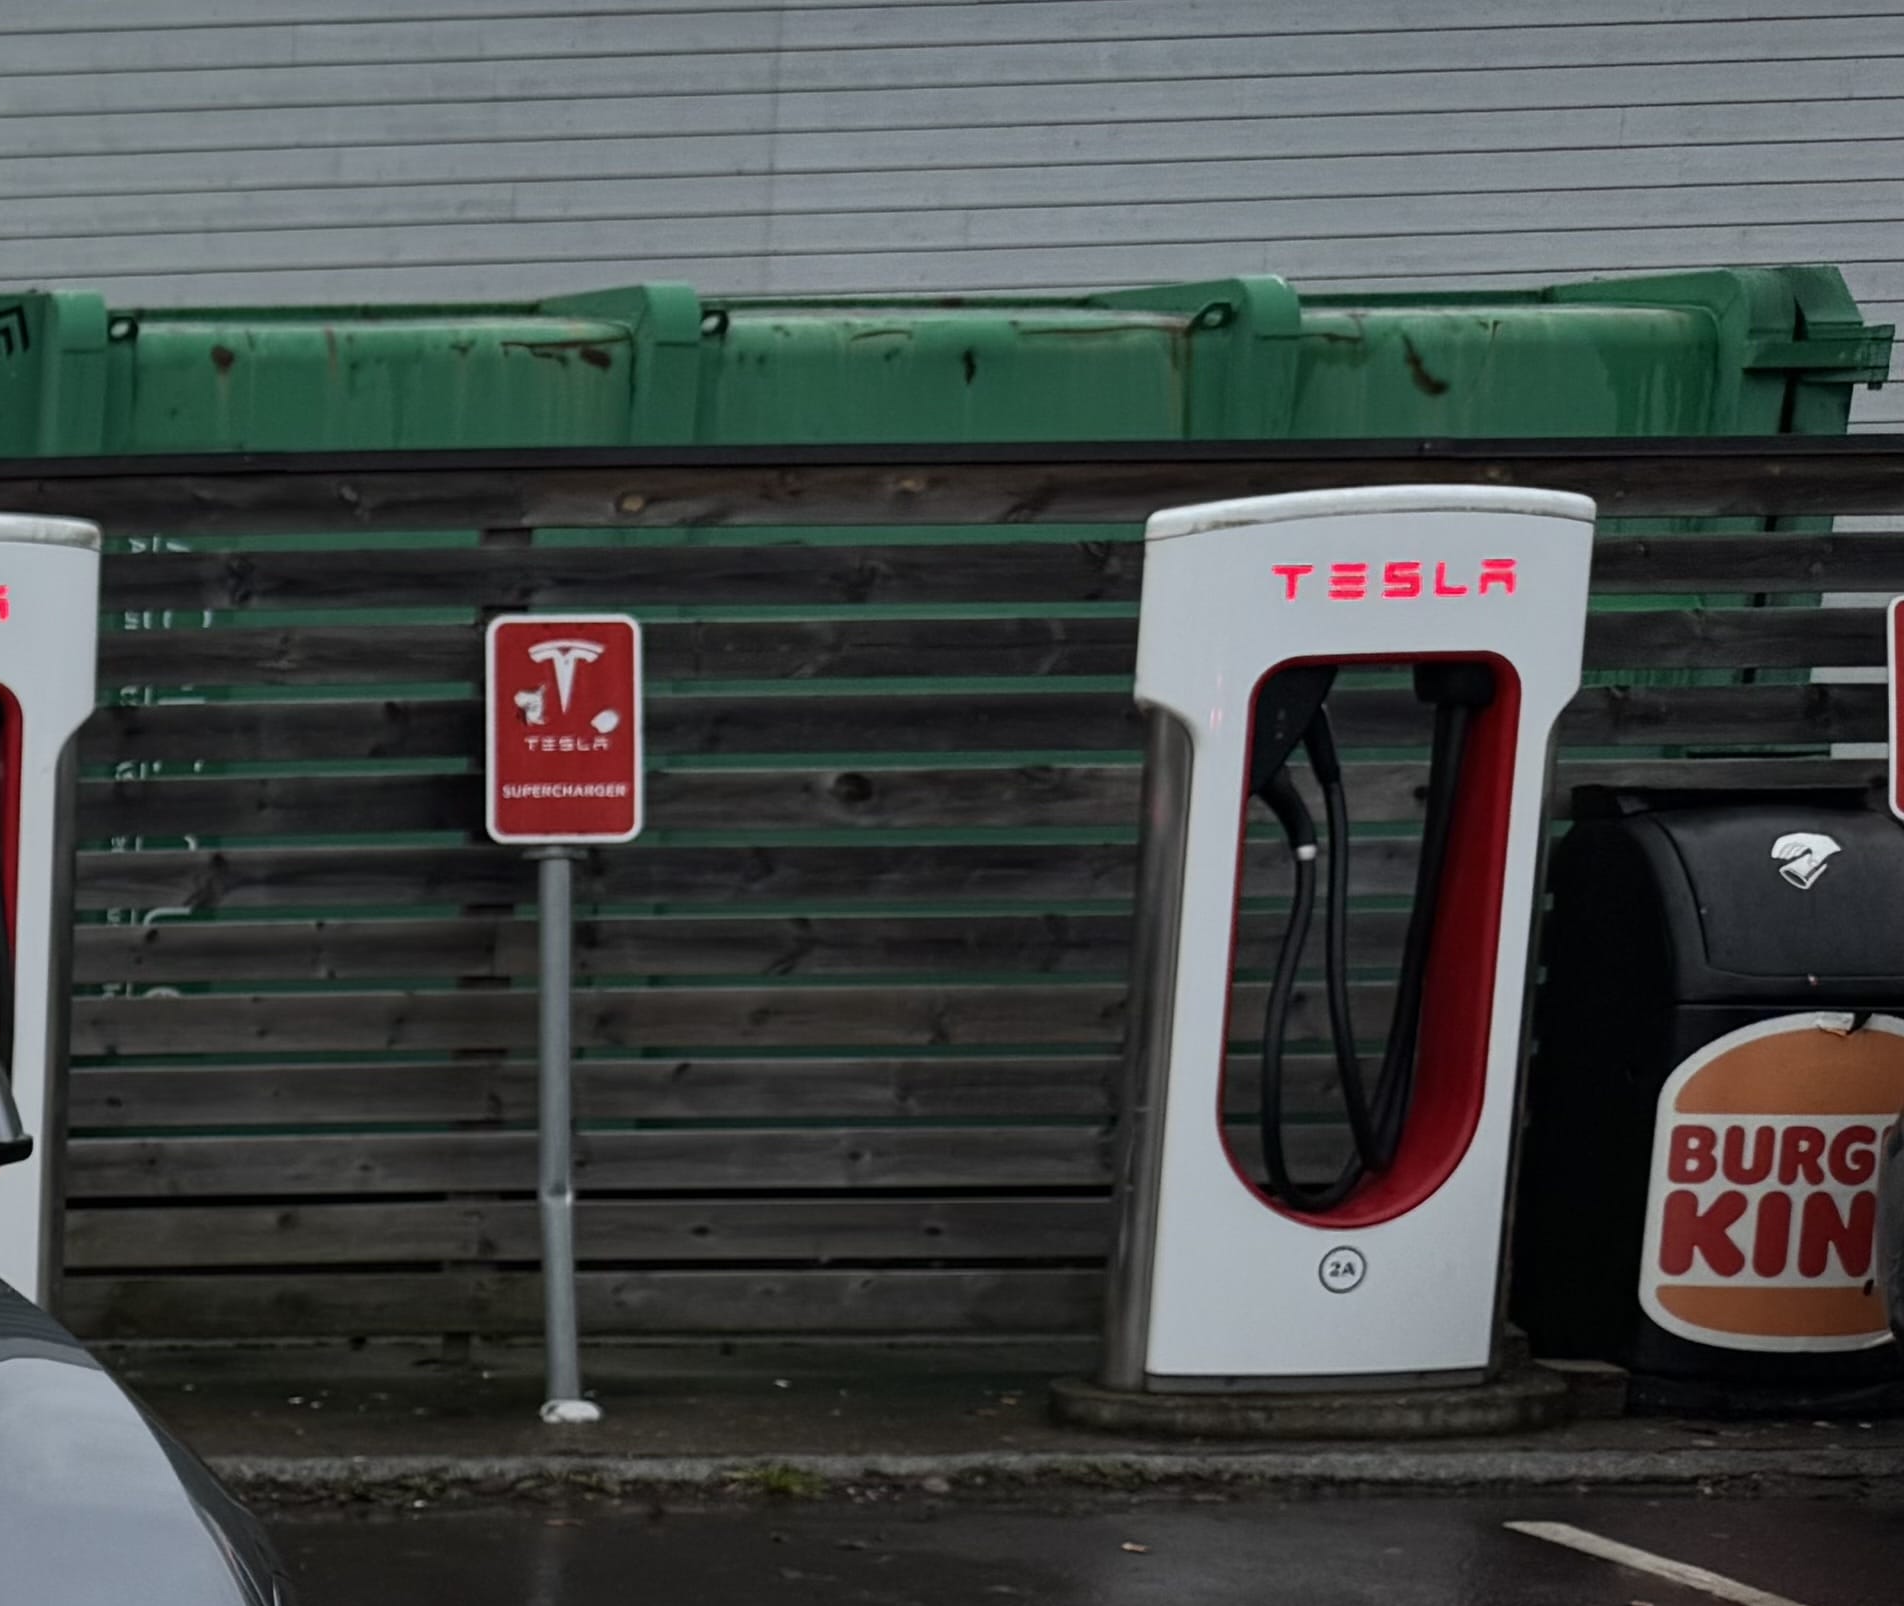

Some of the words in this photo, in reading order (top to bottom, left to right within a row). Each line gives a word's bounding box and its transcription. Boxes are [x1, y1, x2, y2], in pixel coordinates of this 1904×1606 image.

[1272, 558, 1517, 601] TESLA
[525, 736, 608, 752] TESLA
[502, 783, 629, 799] SUPERCHARGER
[1667, 1124, 1895, 1186] BURG
[1658, 1189, 1878, 1278] KIN
